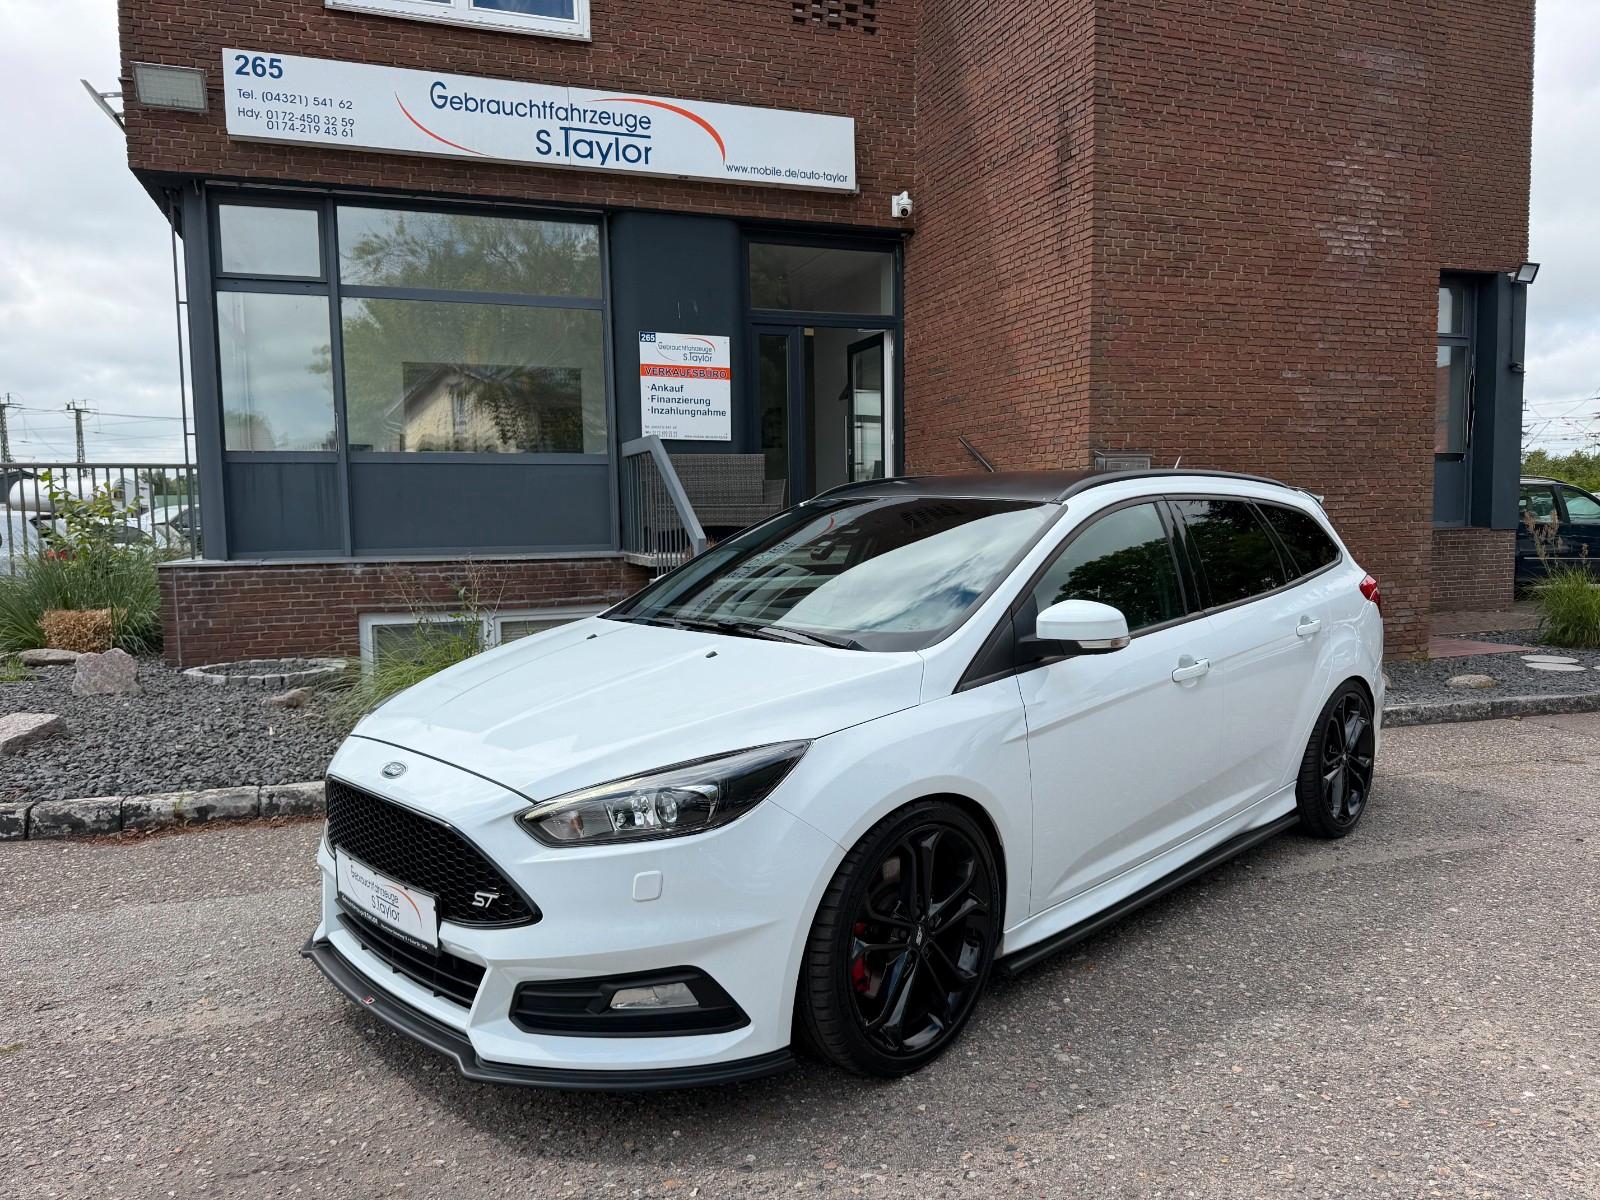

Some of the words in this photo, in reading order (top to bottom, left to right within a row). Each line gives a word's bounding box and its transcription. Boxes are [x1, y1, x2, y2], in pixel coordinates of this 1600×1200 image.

[234, 54, 284, 79] 265
[237, 88, 257, 100] Tel.
[261, 91, 309, 107] (04321)
[313, 96, 334, 108] 541
[339, 99, 353, 110] 62
[429, 81, 652, 133] Gebrauchtfahrzeuge
[237, 107, 262, 120] Hdy.
[266, 109, 321, 124] 0172-450
[324, 114, 338, 126] 32
[341, 116, 355, 128] 59
[266, 120, 321, 135] 0174-219
[324, 124, 338, 137] 43
[341, 126, 354, 138] 61
[535, 127, 652, 166] S.Taylor
[725, 163, 848, 184] www.mobile.de/auto-taylor
[640, 333, 656, 342] 265
[682, 352, 712, 363] S.Taylor
[645, 367, 727, 378] VERKAUFSBÜRO
[471, 891, 500, 908] ST
